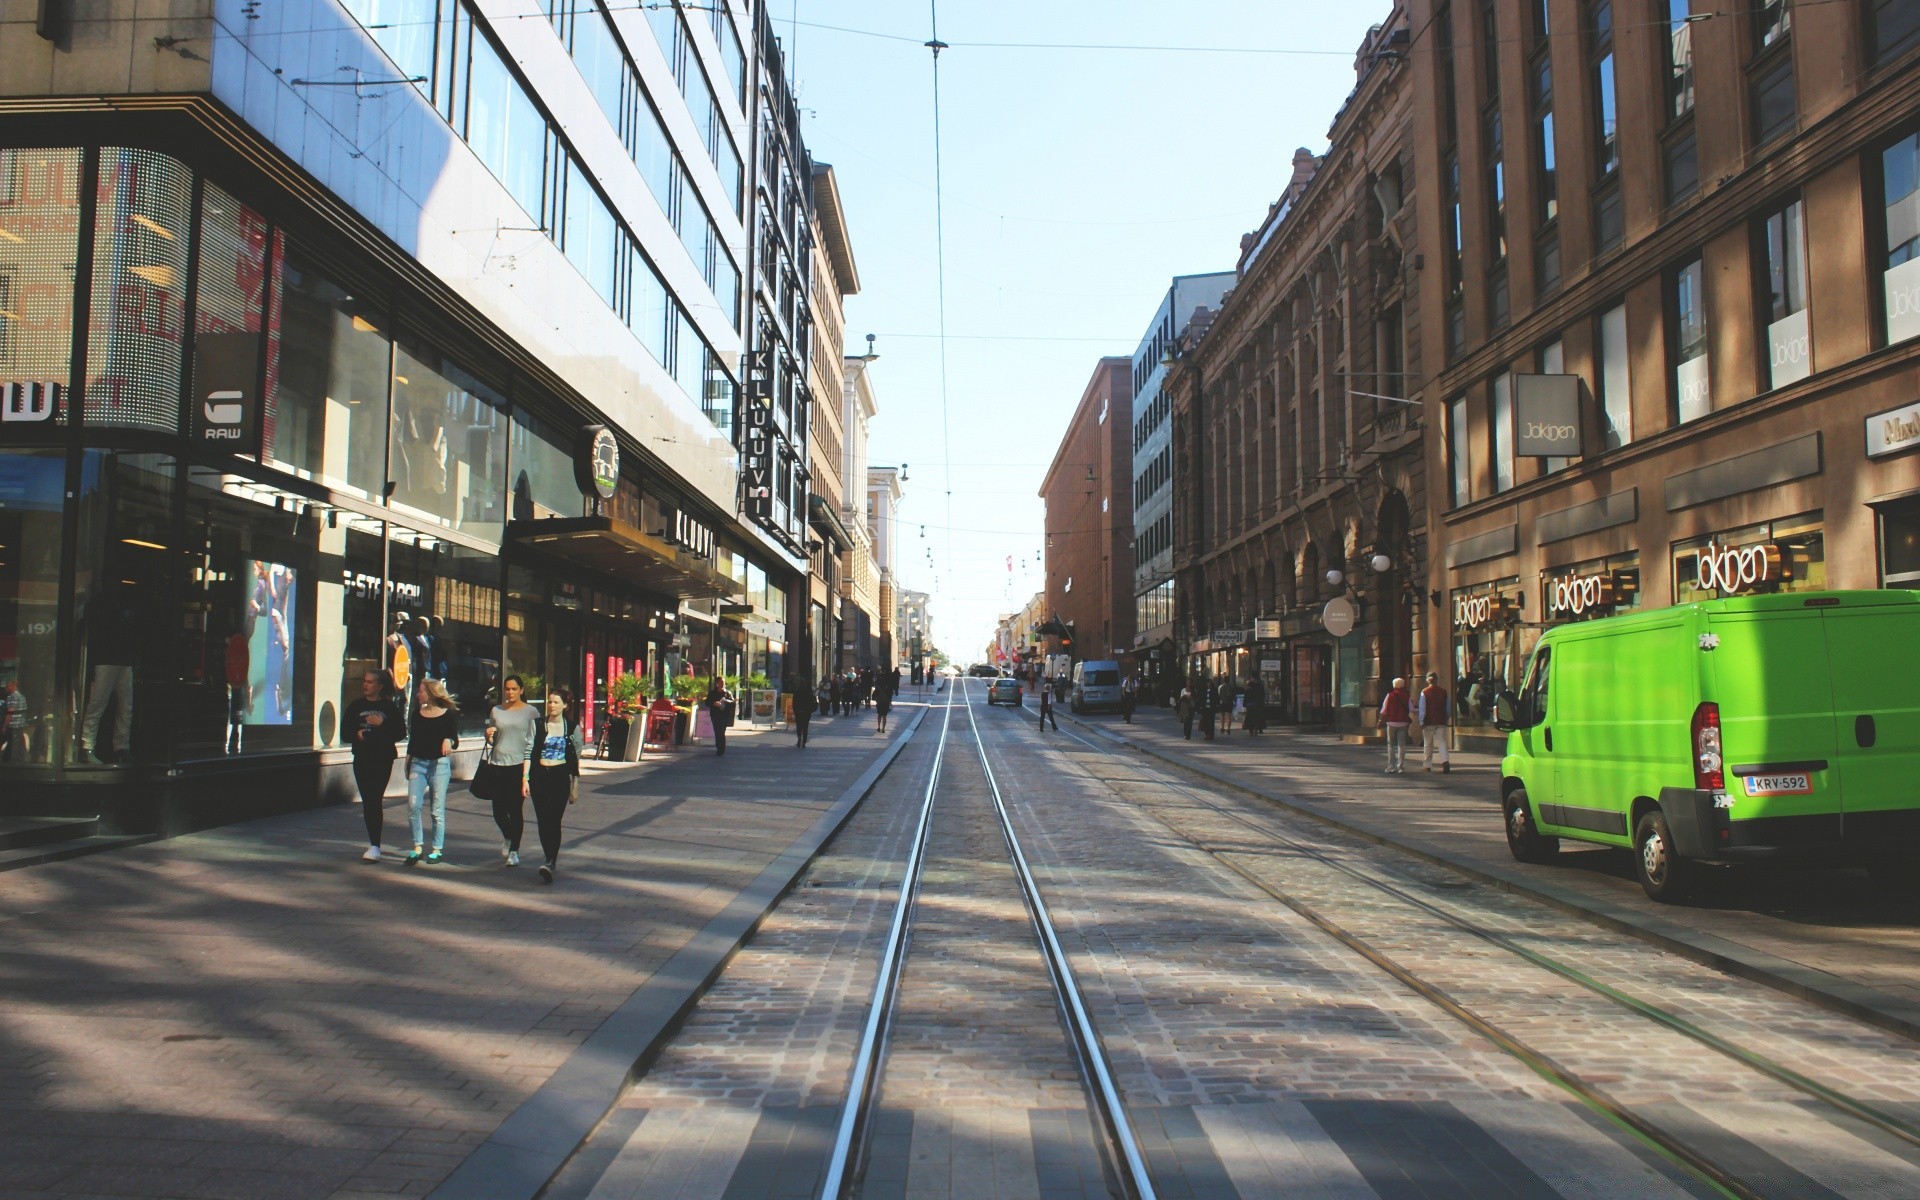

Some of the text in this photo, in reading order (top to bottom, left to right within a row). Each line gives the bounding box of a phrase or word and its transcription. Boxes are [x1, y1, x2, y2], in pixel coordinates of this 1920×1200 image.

[205, 428, 241, 439] RAW
[753, 353, 767, 514] KLUUVI
[1523, 422, 1576, 442] Jokinen
[675, 508, 713, 559] KLUUVI
[1689, 541, 1768, 593] Jokinen
[1550, 574, 1602, 614] Jokinen
[1755, 777, 1806, 790] KRV-592
